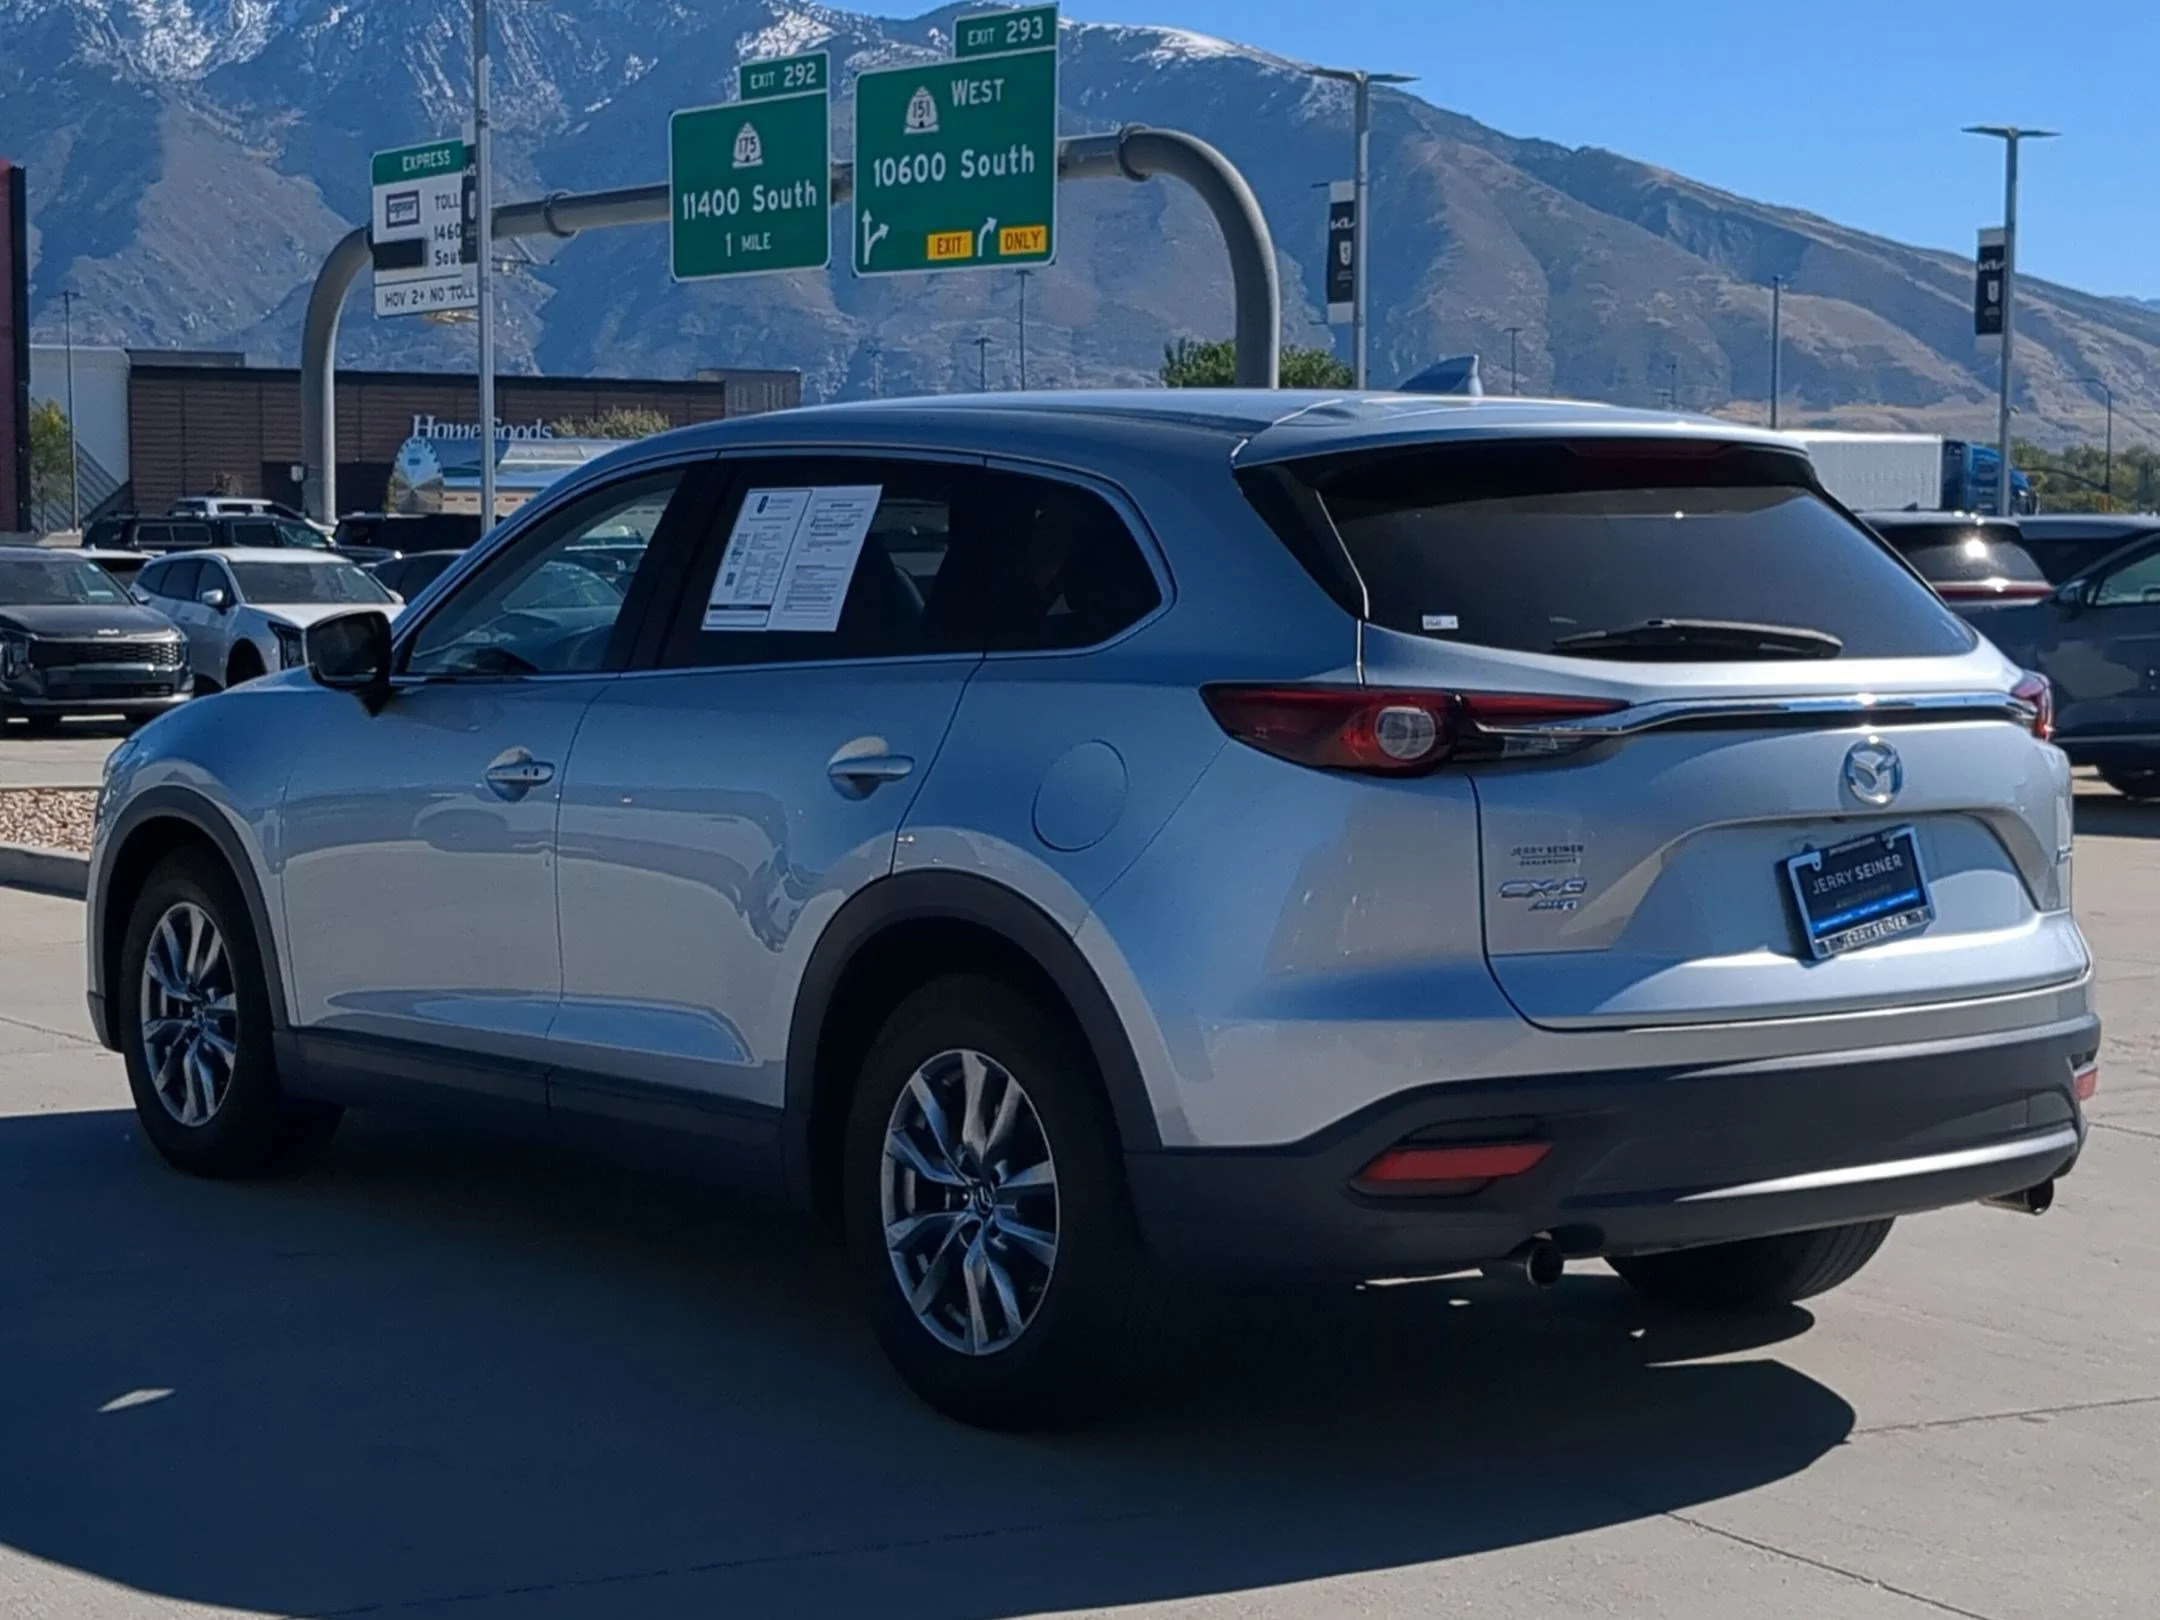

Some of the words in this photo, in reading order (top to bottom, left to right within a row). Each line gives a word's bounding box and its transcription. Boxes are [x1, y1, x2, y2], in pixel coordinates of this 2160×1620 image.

[967, 27, 995, 46] EXIT
[1005, 16, 1043, 44] 293
[751, 71, 775, 89] EXIT
[783, 62, 817, 87] 292
[951, 78, 1004, 107] WEST
[912, 100, 931, 119] 151
[738, 136, 757, 155] 175
[402, 149, 451, 172] EXPRESS
[873, 152, 946, 187] 10600
[960, 145, 1035, 179] South
[682, 187, 740, 221] 11400
[752, 179, 817, 213] South
[725, 232, 732, 257] 1
[741, 232, 771, 252] MILE
[936, 235, 963, 256] EXIT
[1004, 229, 1042, 251] ONLY
[384, 290, 406, 308] HOV
[431, 286, 445, 303] NO
[1812, 867, 1853, 895] JERRY
[1854, 853, 1903, 880] SEINER
